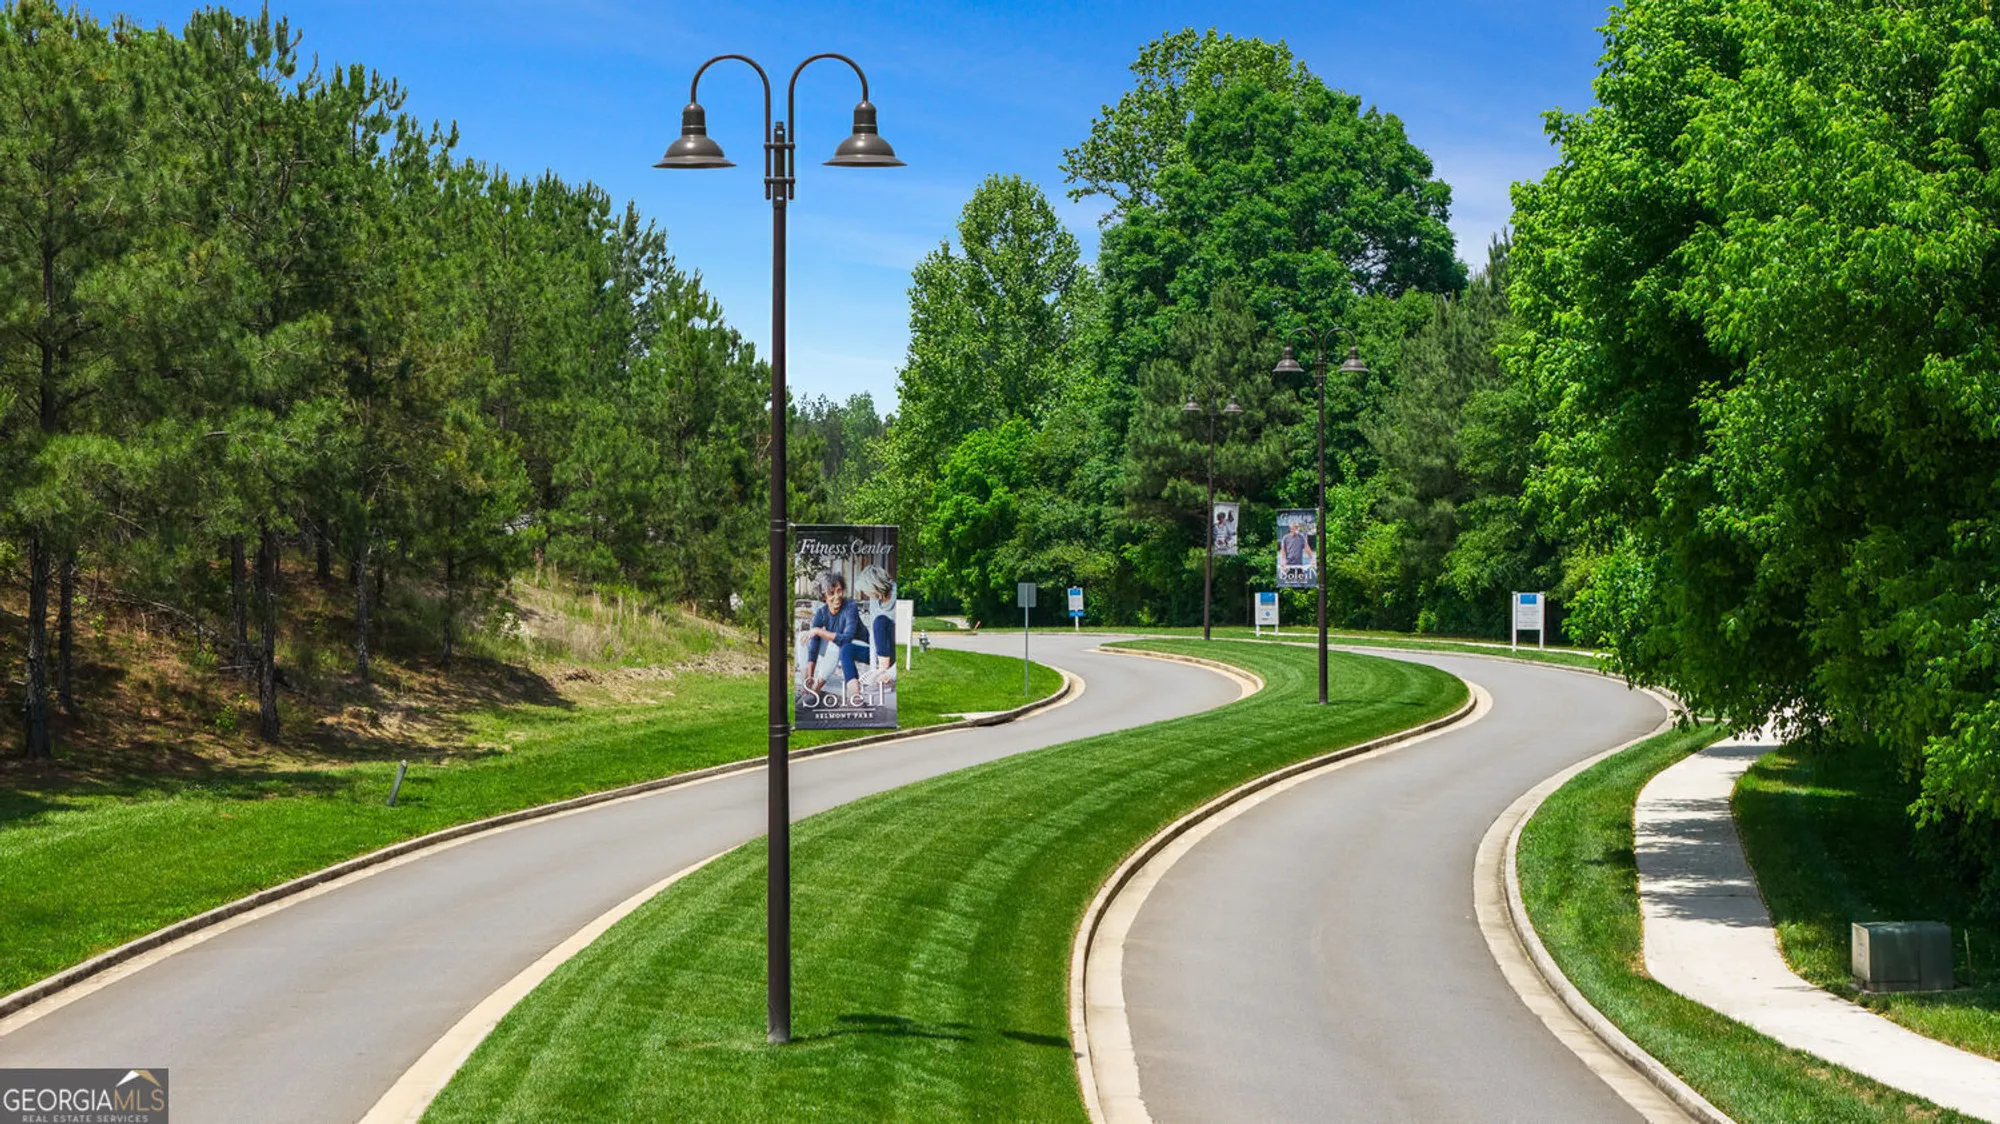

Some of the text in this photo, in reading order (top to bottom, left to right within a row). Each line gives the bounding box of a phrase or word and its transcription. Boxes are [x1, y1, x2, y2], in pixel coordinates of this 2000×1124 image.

[801, 538, 893, 554] Fitness Center
[802, 677, 886, 708] Soleil
[815, 712, 851, 720] BELMONT
